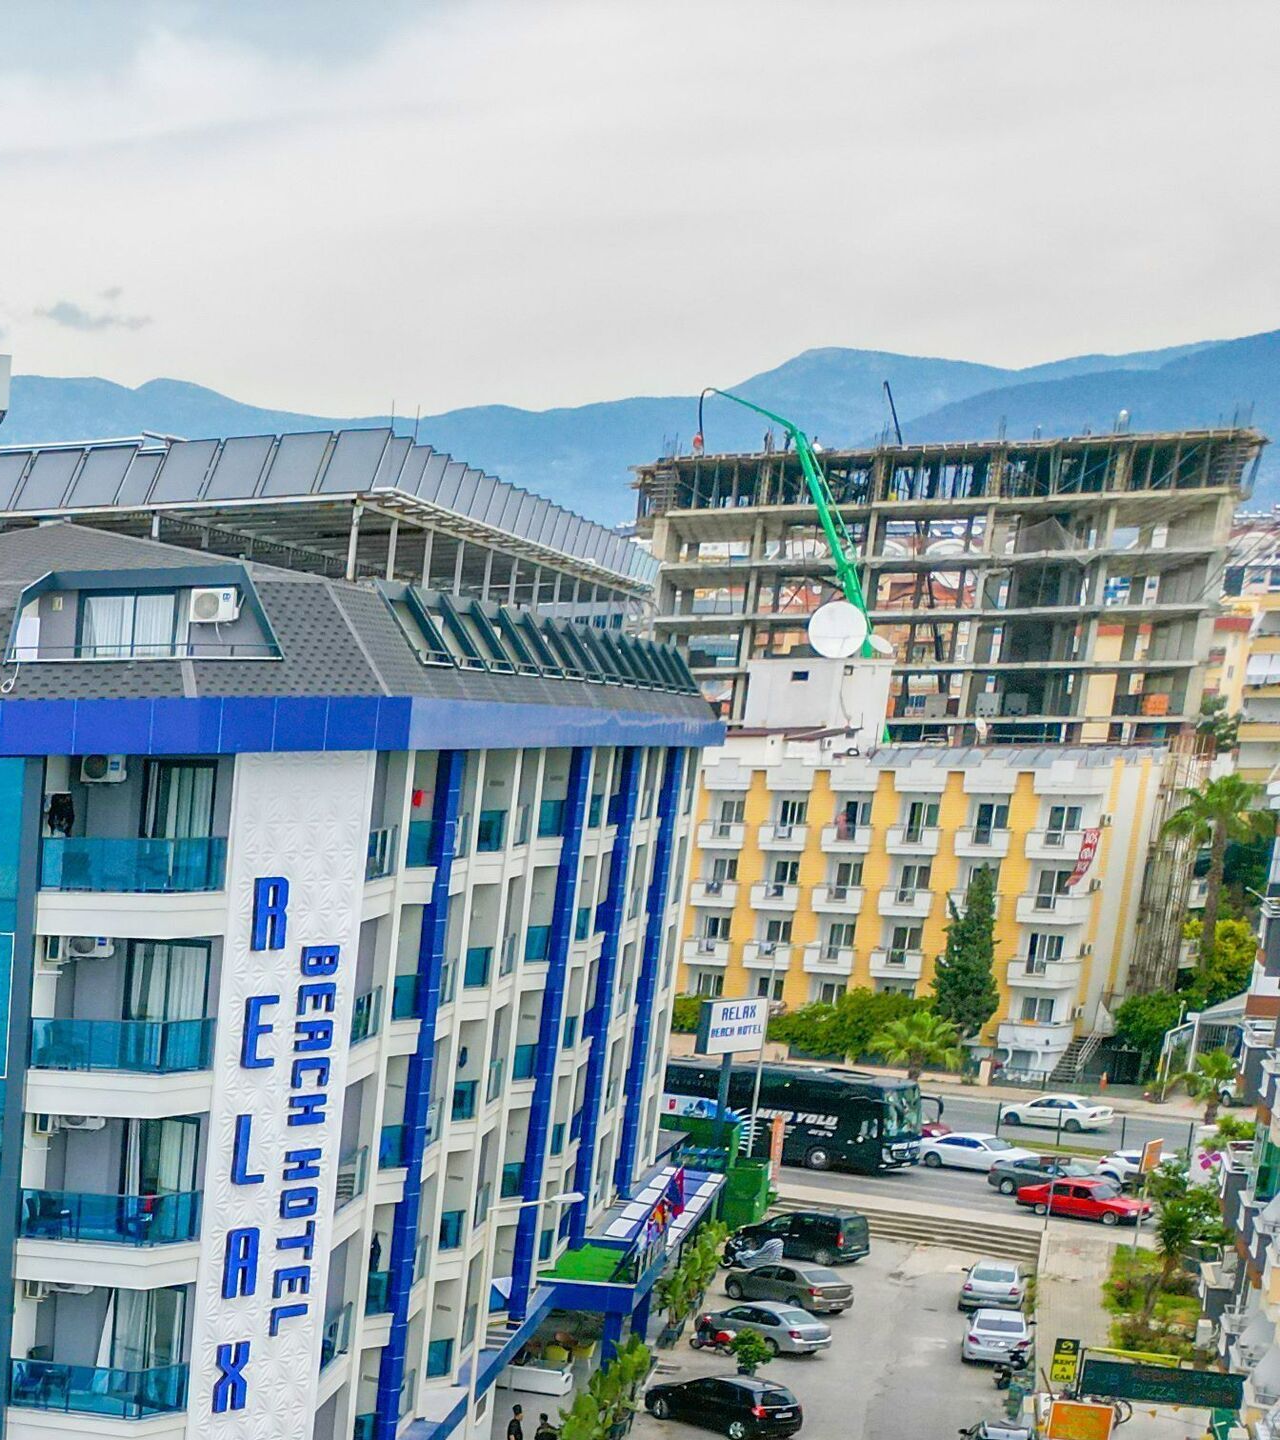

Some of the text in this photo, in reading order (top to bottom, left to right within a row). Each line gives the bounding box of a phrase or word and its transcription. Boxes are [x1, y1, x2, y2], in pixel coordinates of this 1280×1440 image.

[722, 1005, 757, 1021] RELAX
[711, 1024, 762, 1038] BEACH HOTEL
[211, 876, 289, 1413] RELAX
[269, 945, 340, 1337] BEACH HOTEL
[1054, 1359, 1076, 1367] RENT
